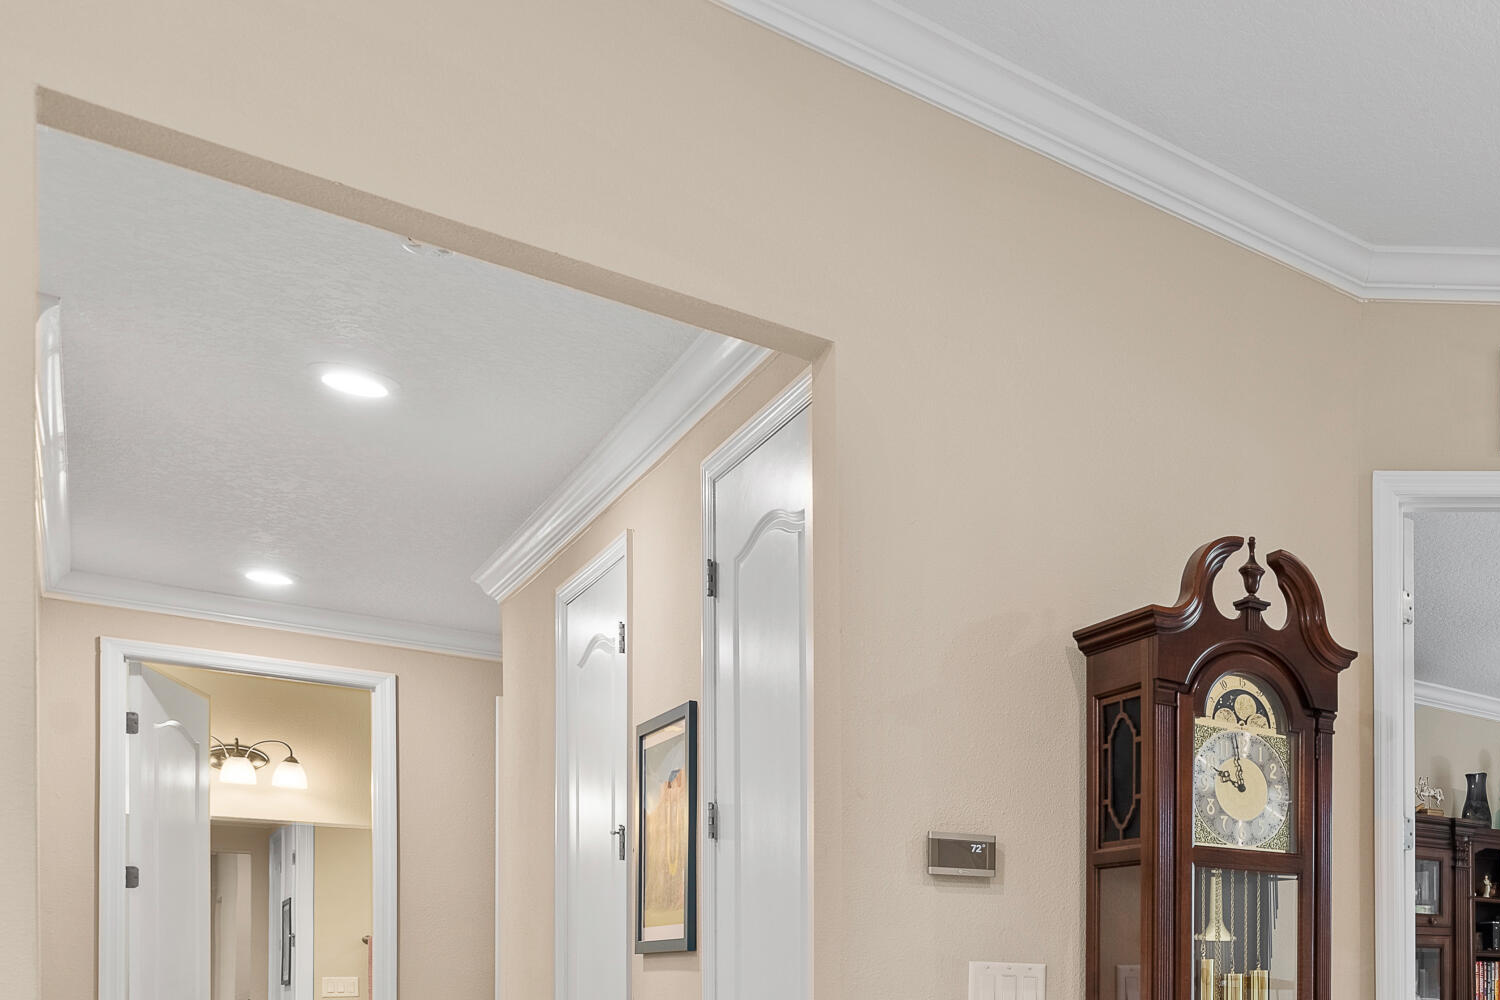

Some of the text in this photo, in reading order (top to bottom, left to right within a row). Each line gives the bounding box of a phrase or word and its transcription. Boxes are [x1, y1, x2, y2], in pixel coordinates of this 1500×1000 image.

[1269, 763, 1277, 779] 2
[1201, 775, 1209, 791] 9
[1275, 785, 1282, 800] 3
[1207, 798, 1215, 815] 8
[1221, 816, 1229, 833] 7
[970, 843, 986, 853] 72°
